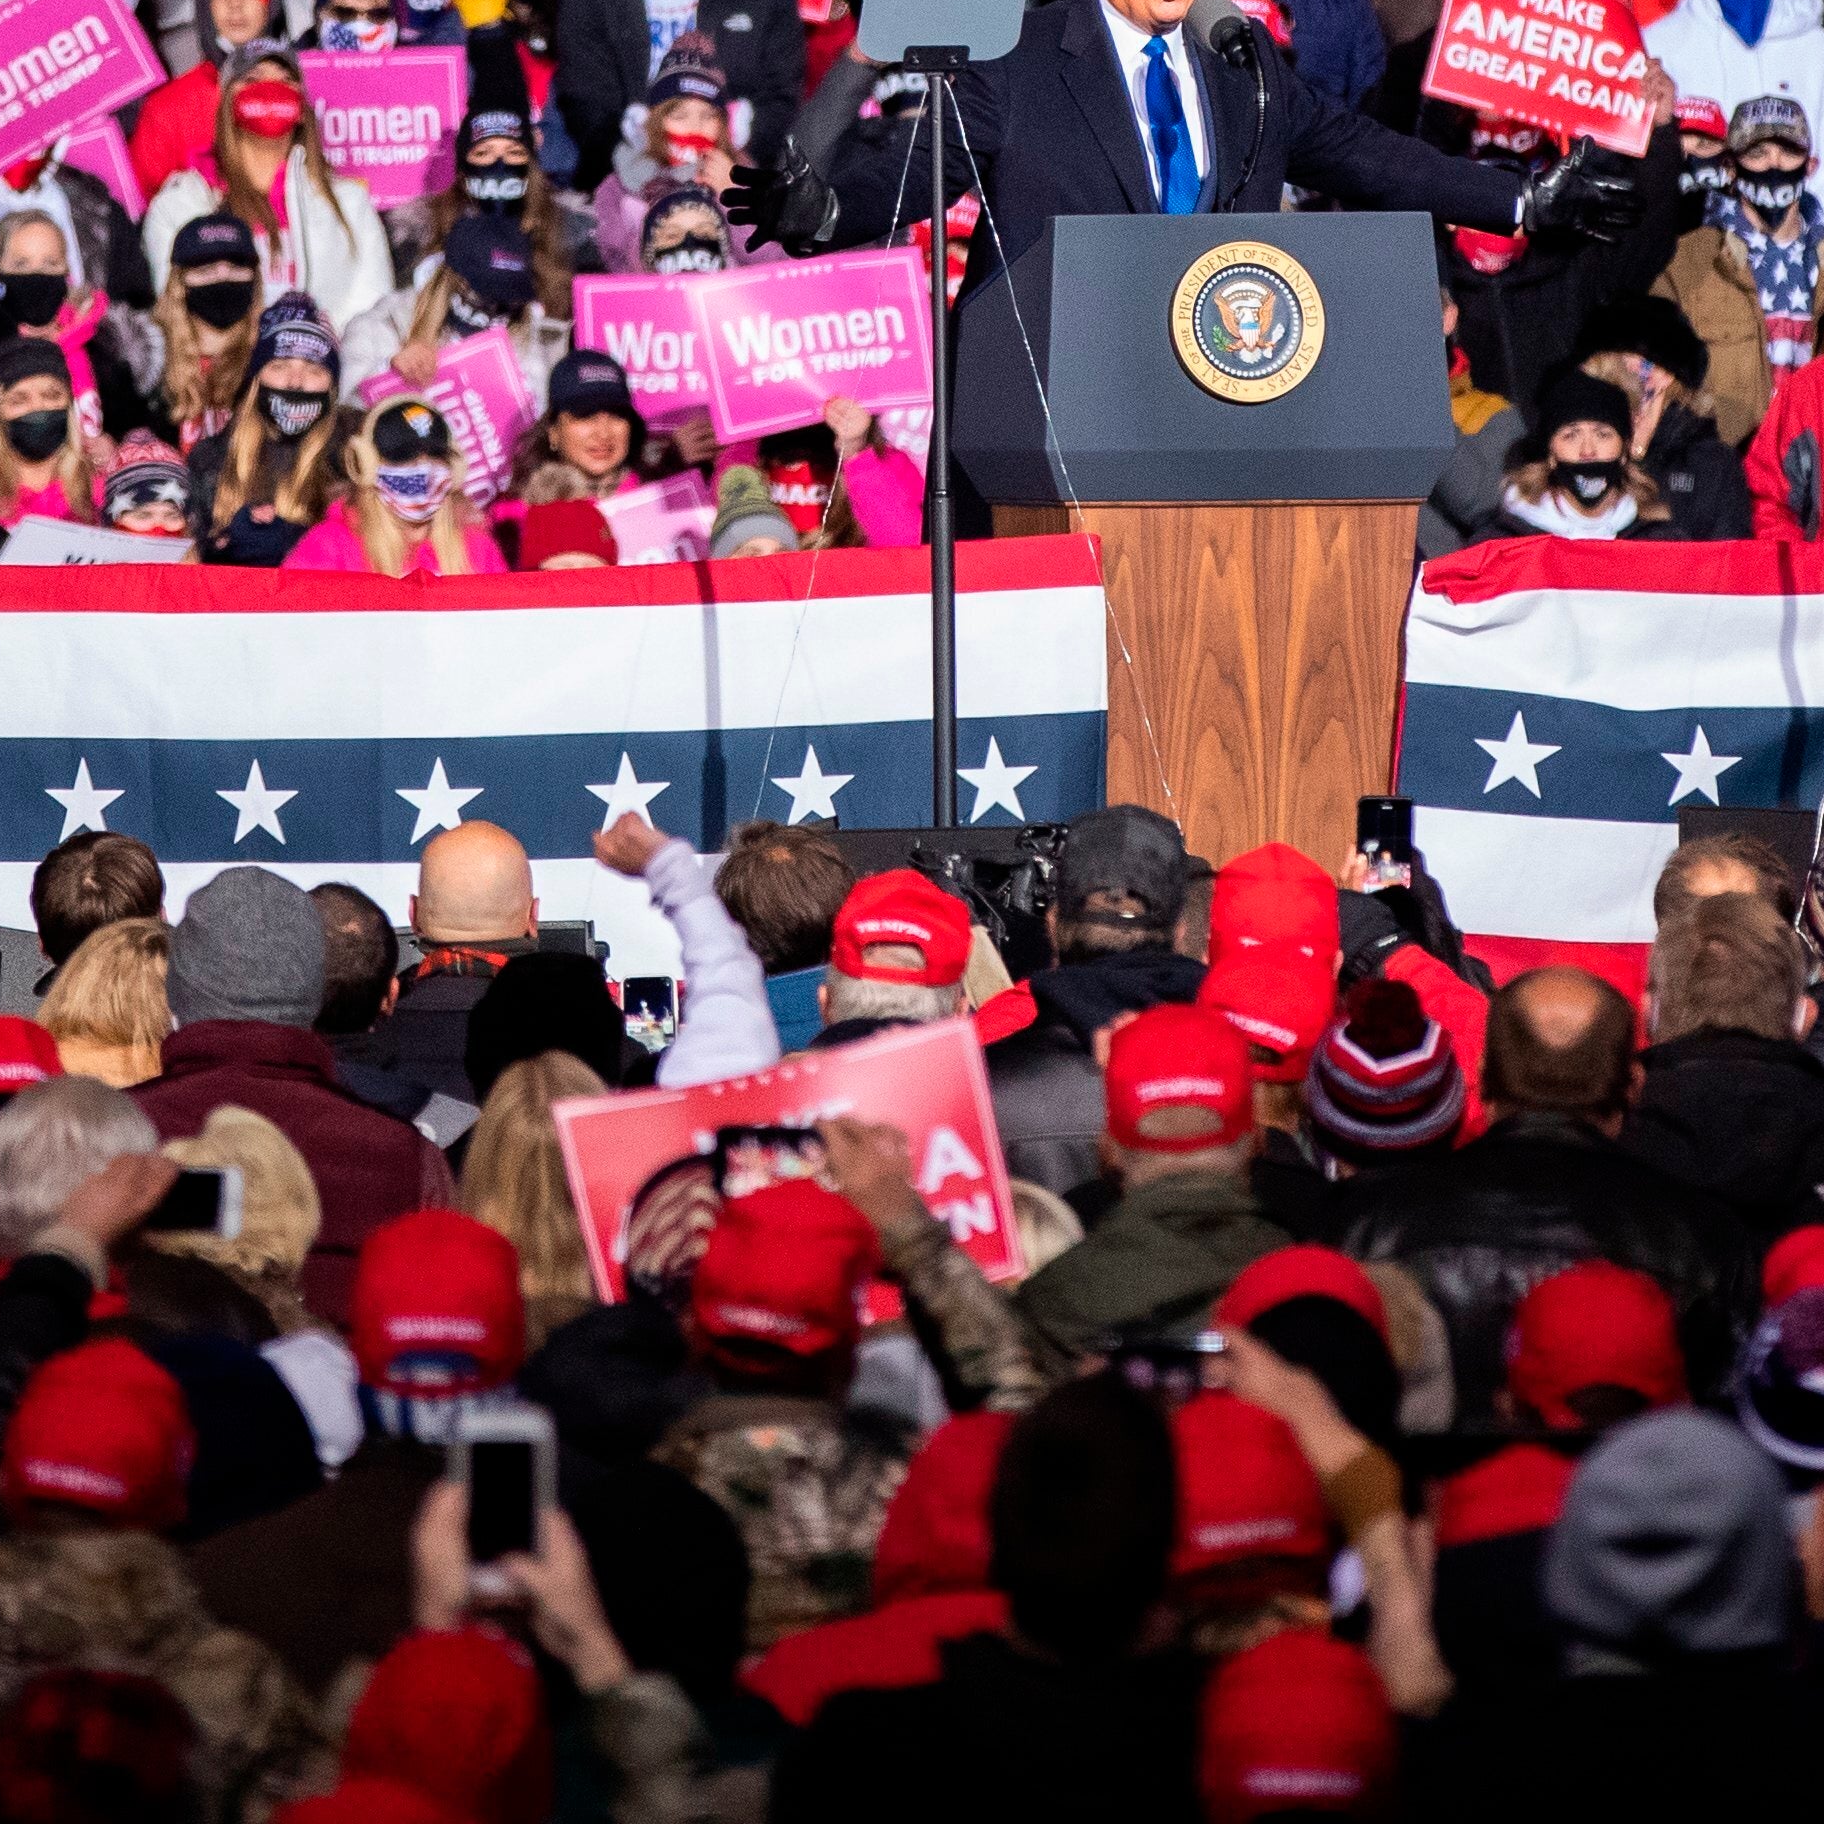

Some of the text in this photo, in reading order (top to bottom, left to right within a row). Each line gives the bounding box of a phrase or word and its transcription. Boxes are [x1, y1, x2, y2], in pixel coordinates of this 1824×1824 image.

[1454, 1, 1653, 79] AMERICA
[33, 53, 103, 108] TRUMP
[1446, 44, 1649, 122] GREAT AGAIN
[355, 145, 428, 166] TRUMP
[724, 306, 904, 367] Women
[1178, 249, 1318, 394] SEAL OF THE PRESIDENT OF THE UNITED STATES
[751, 348, 892, 386] FOR TRUMP
